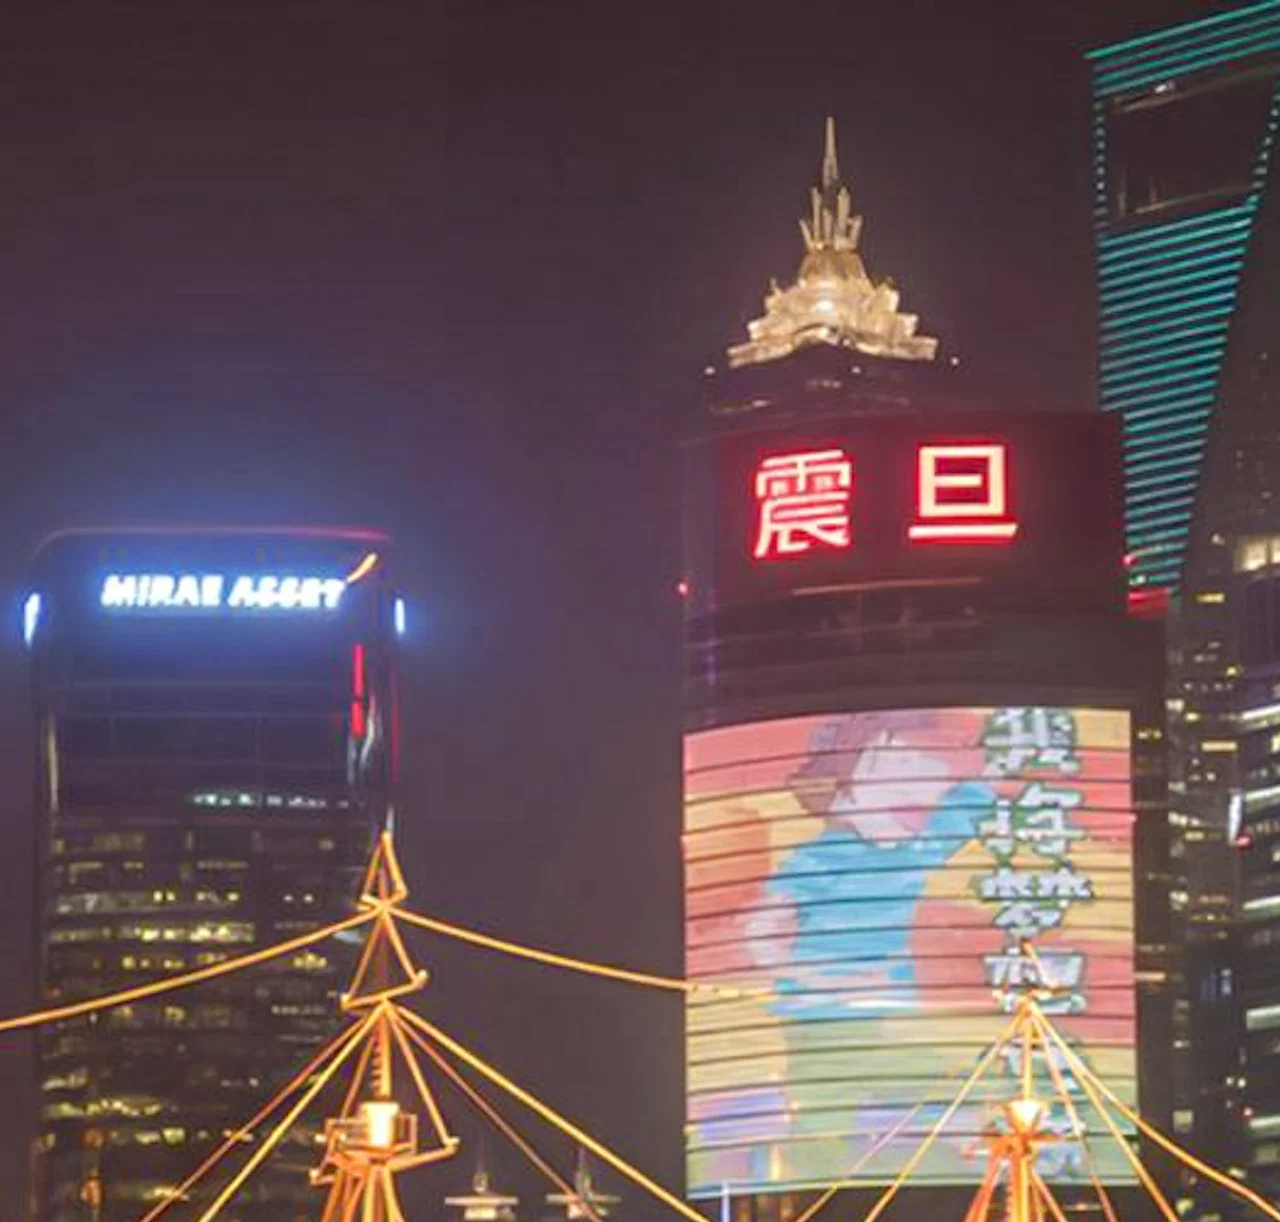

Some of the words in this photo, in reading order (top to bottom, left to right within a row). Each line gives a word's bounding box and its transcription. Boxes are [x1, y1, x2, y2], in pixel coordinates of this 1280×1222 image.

[753, 445, 1018, 558] 震旦
[100, 574, 222, 607] MIRAE
[227, 575, 346, 608] ASSET
